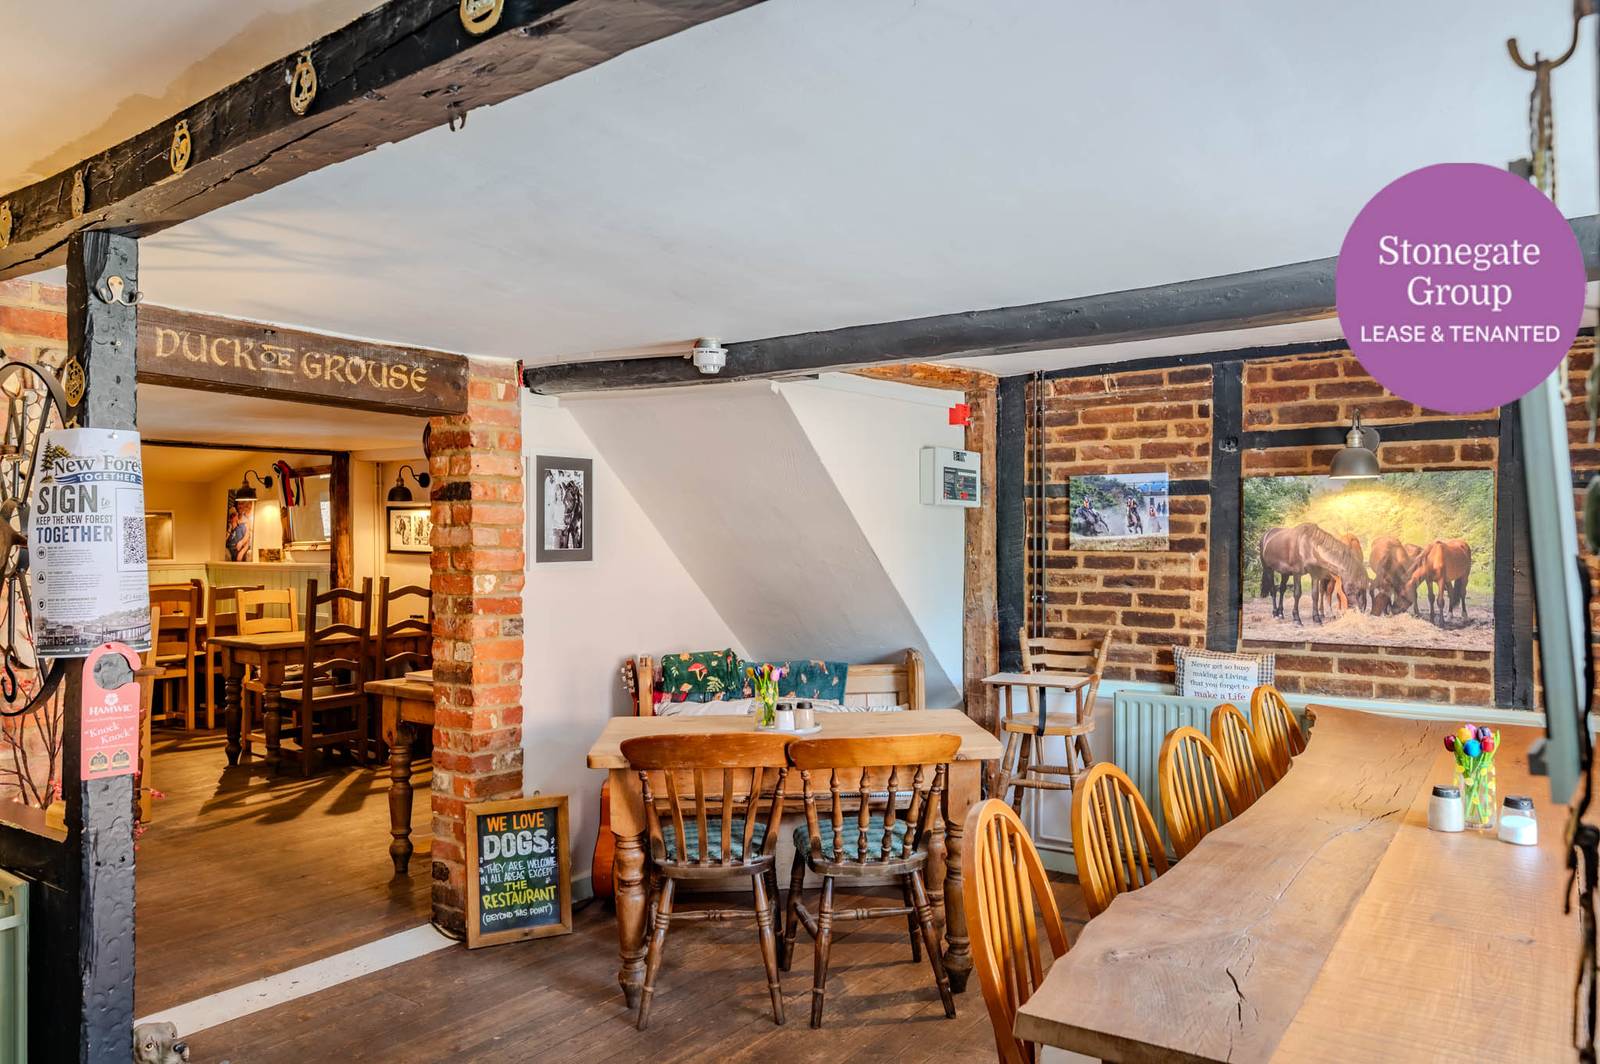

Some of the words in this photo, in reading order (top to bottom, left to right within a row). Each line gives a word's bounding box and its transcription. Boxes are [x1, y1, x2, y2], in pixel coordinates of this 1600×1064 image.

[154, 327, 256, 371] DUCK
[260, 350, 291, 367] OR
[301, 351, 428, 392] GROUSE
[54, 457, 96, 476] New
[77, 473, 138, 483] TOGETHER
[37, 485, 98, 515] SIGN
[36, 515, 51, 526] KEEP
[52, 515, 64, 525] THE
[66, 515, 82, 524] NEW
[84, 514, 113, 524] FOREST
[36, 526, 113, 544] TOGETHER
[1191, 660, 1211, 669] Never
[1190, 679, 1204, 687] that
[1205, 681, 1218, 689] you
[1220, 681, 1241, 690] forget
[1192, 671, 1217, 680] making
[1225, 673, 1248, 681] Living
[1194, 690, 1218, 700] make
[1228, 692, 1246, 700] Life
[487, 815, 507, 832] WE
[513, 812, 545, 830] LOVE
[483, 828, 550, 861] DOGS
[485, 861, 506, 874] THEY
[508, 859, 525, 871] ARE
[526, 856, 557, 869] WELCOME
[480, 874, 488, 885] IN
[490, 873, 501, 884] ALL
[503, 870, 525, 882] AREAS
[529, 868, 554, 878] EXCEPT
[504, 880, 527, 891] THE
[482, 886, 556, 909] RESTAURANT
[482, 911, 514, 926] (BEYOND
[514, 907, 527, 917] THIS
[529, 903, 553, 916] POINT)
